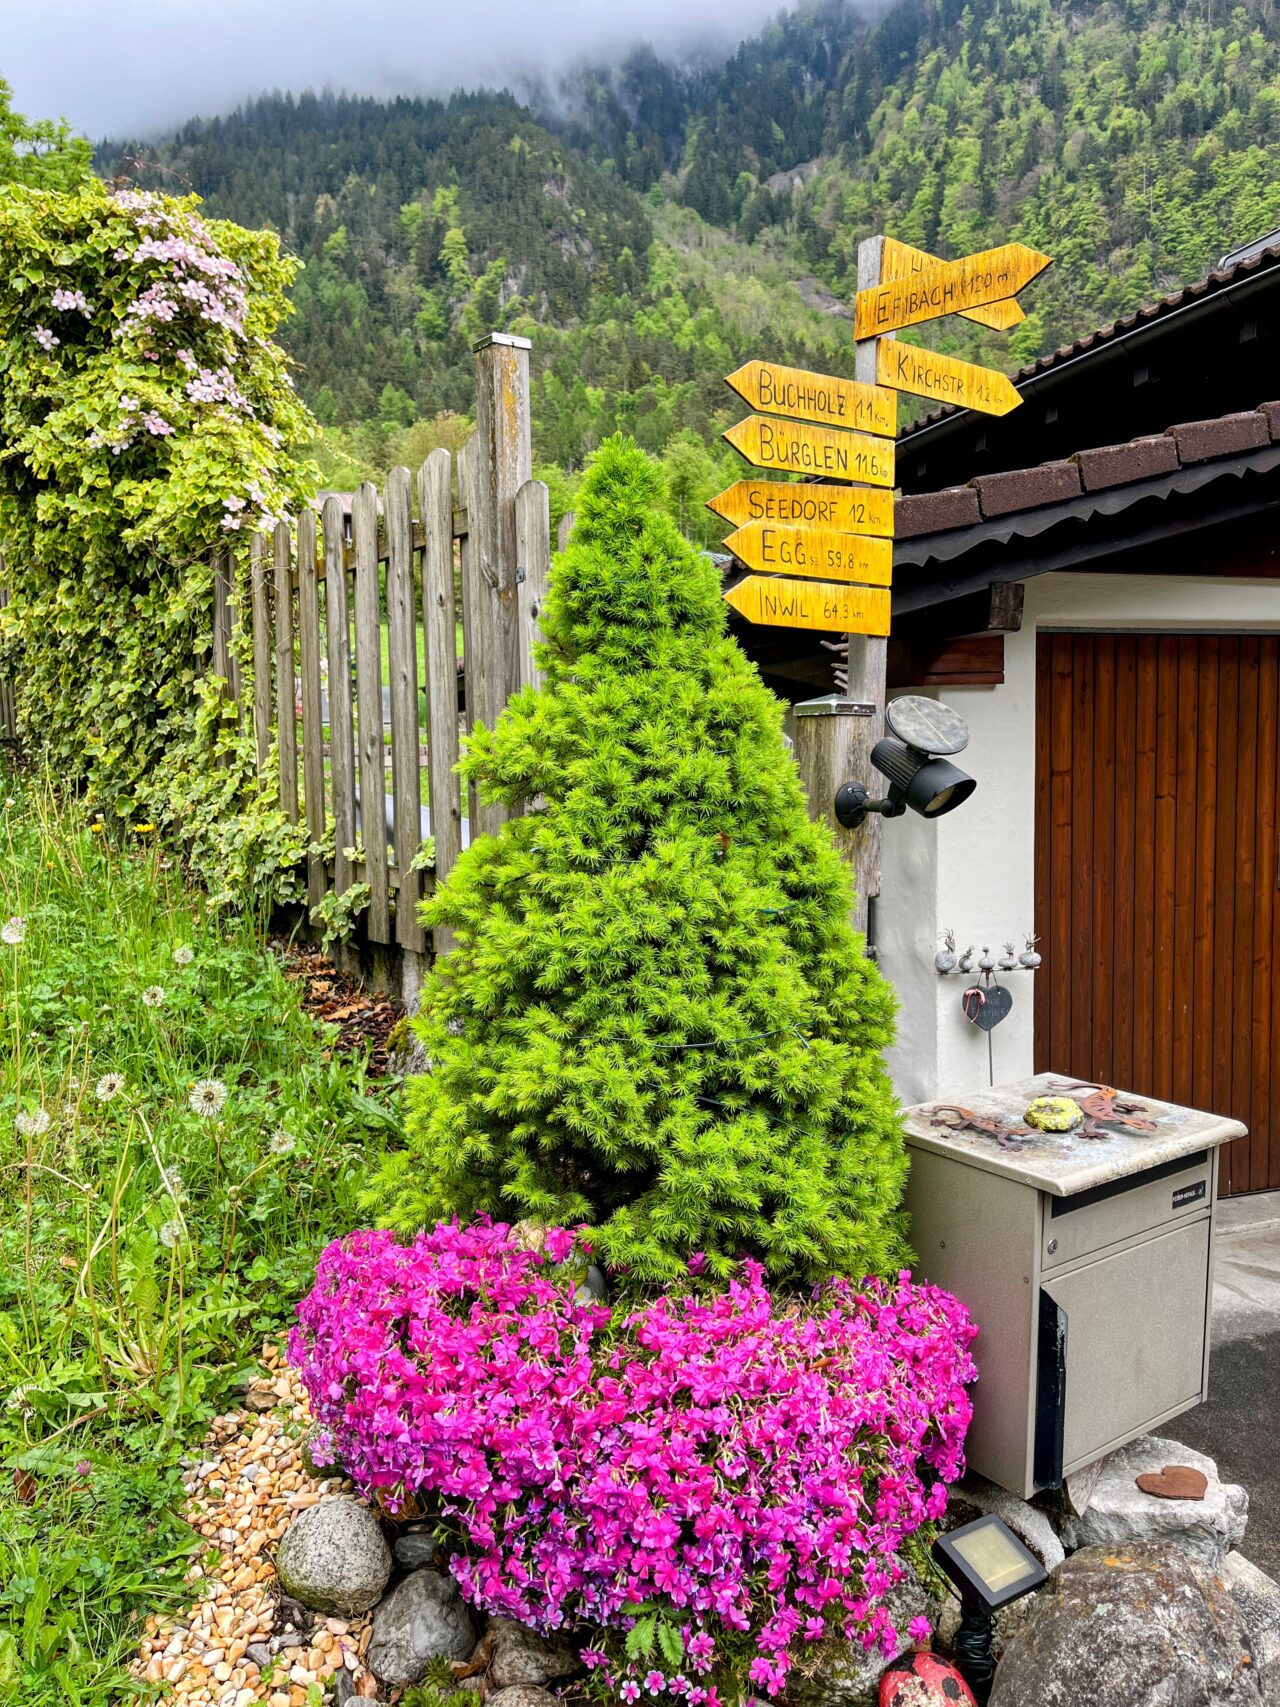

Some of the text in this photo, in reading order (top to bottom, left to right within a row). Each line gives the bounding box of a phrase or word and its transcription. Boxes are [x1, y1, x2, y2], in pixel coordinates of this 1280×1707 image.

[997, 273, 1008, 283] m
[759, 368, 846, 417] BUCHHOLZ
[897, 351, 964, 396] KIRCHSTR
[759, 423, 848, 472] BÜRGLEN
[748, 490, 838, 522] SEEDORF
[848, 503, 865, 524] 12
[761, 529, 806, 566] EGG
[827, 550, 855, 570] 59.8
[759, 586, 809, 618] INWIL
[823, 600, 849, 620] 64.3
